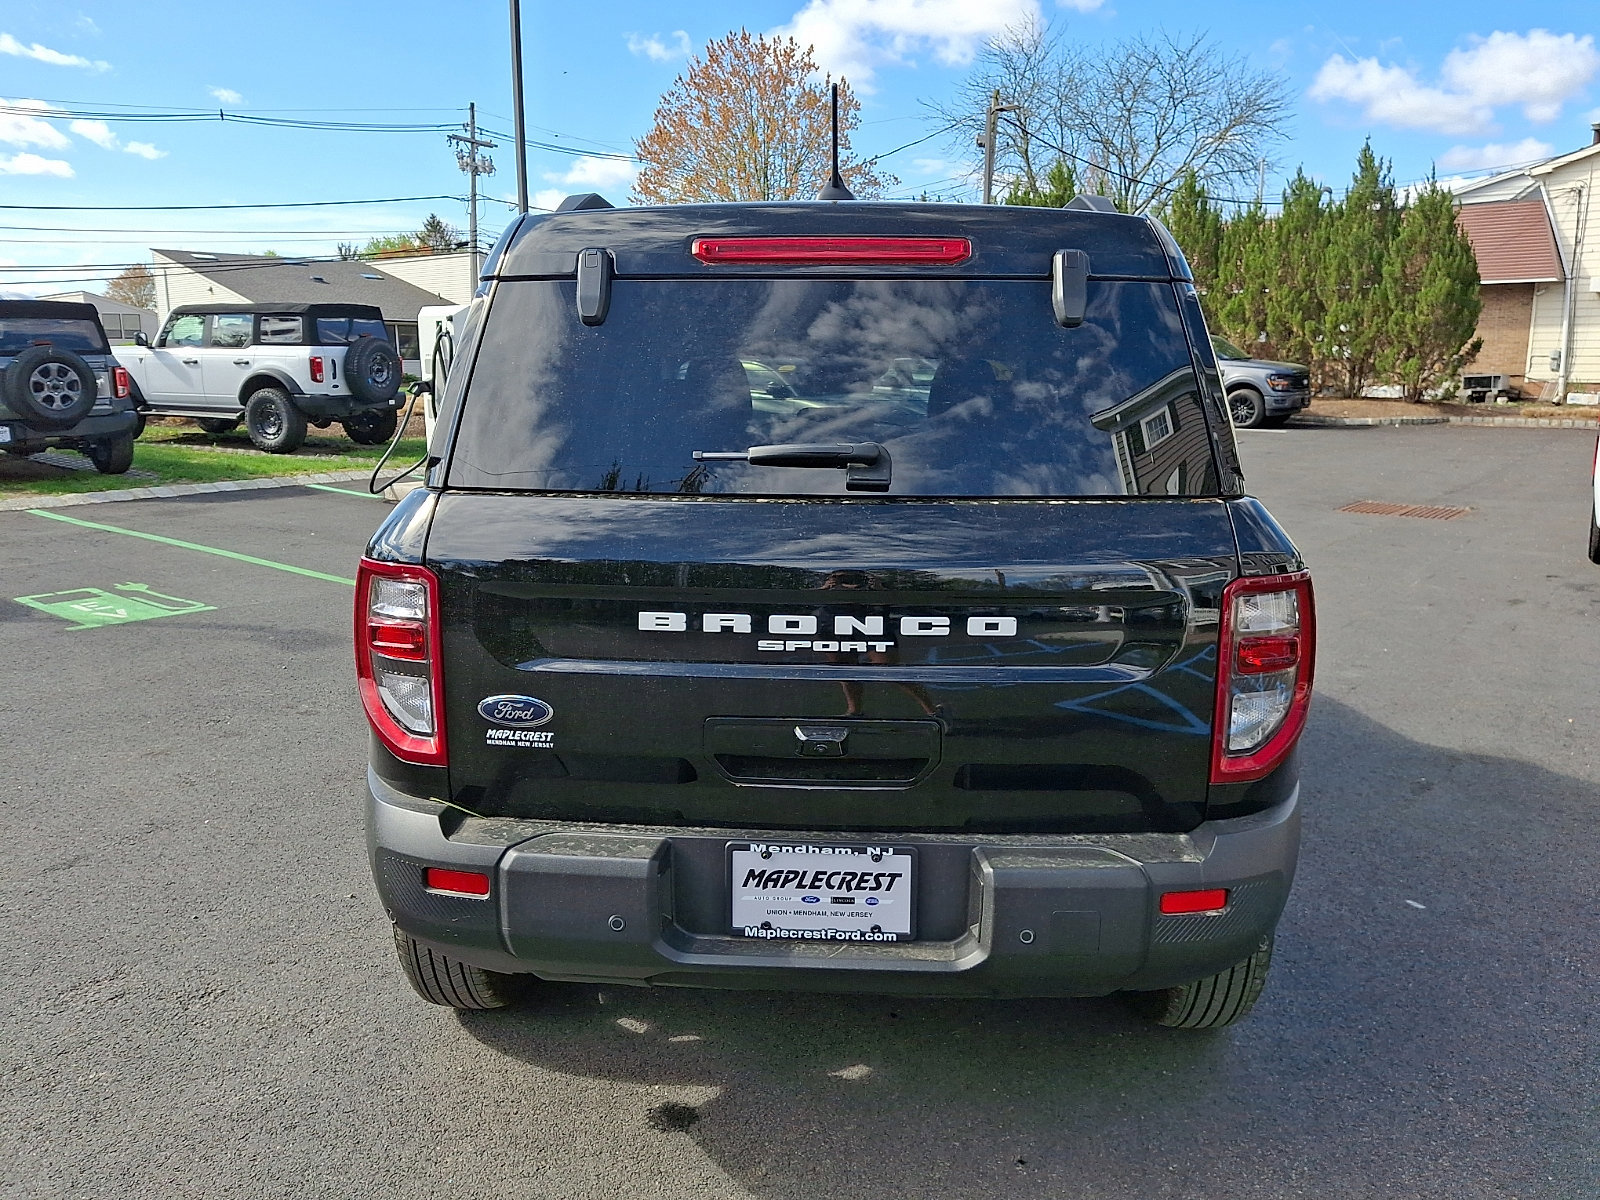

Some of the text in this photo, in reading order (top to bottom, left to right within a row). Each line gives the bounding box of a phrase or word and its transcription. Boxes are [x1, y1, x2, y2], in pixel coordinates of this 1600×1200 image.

[638, 612, 1017, 636] BRONCO
[757, 640, 894, 653] SPORT
[494, 701, 534, 720] Ford
[486, 729, 554, 742] MAPLECREST
[750, 843, 894, 856] Mendham, NJ
[742, 868, 903, 893] MAPLECREST
[744, 926, 897, 941] MaplecrestFord.com
